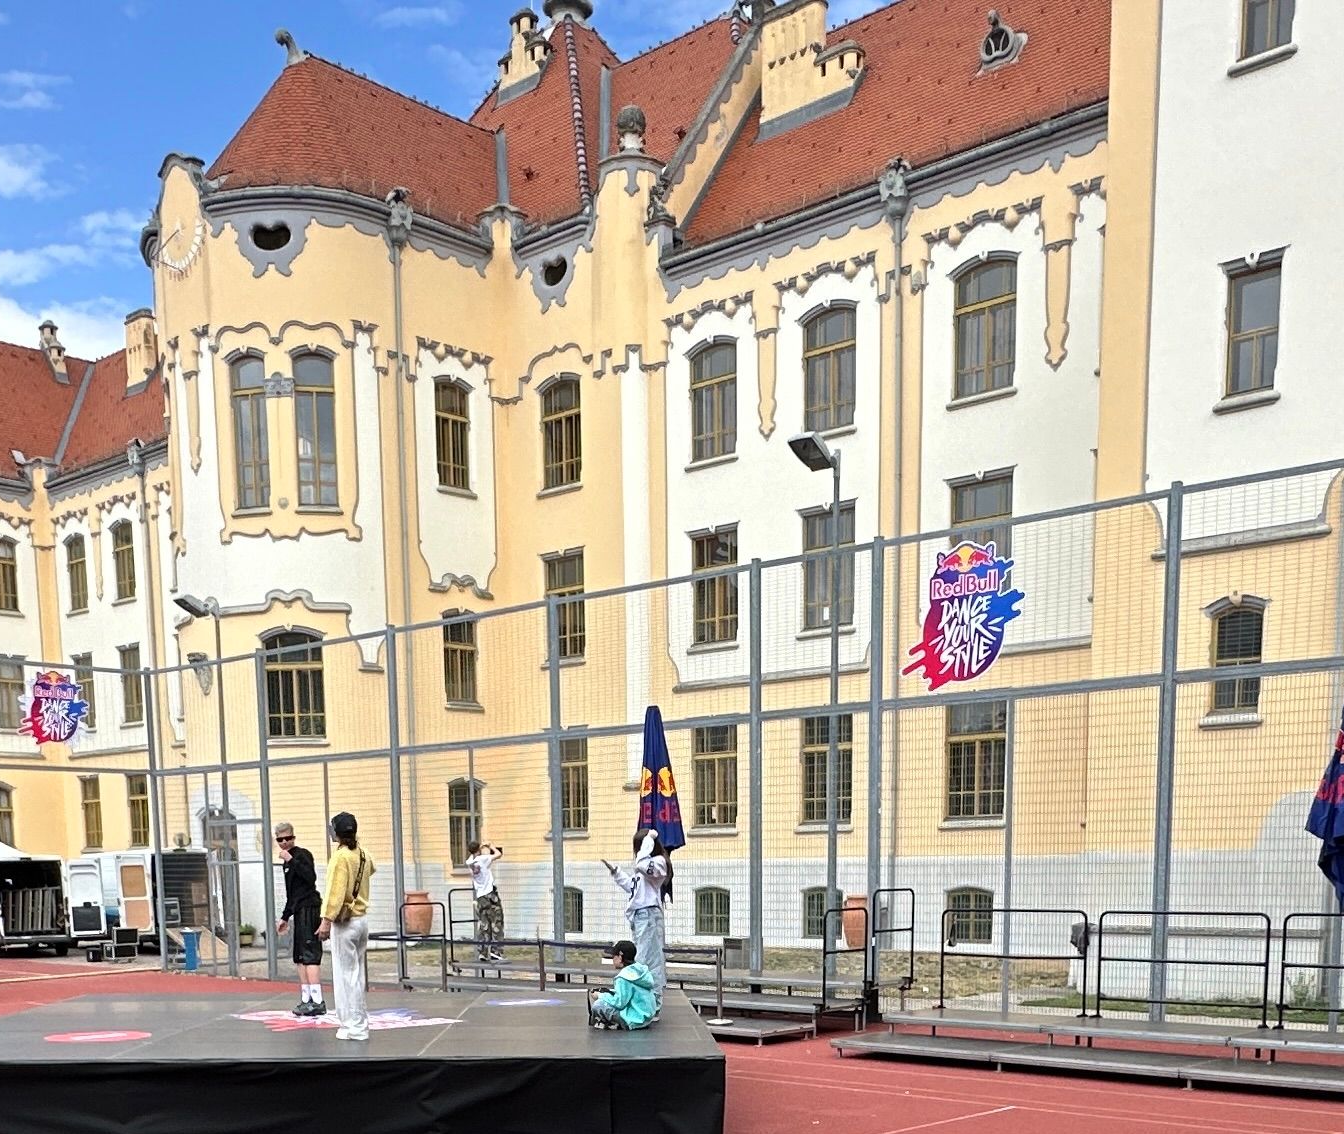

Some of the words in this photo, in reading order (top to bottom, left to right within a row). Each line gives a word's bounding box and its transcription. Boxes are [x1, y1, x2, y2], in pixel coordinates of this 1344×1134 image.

[932, 574, 963, 597] Red
[966, 570, 997, 593] Bull
[937, 595, 992, 631] DANCE
[942, 613, 997, 649] YOUR
[939, 633, 993, 677] STYLE
[35, 685, 54, 697] Red
[39, 698, 71, 713] DANCE
[42, 709, 74, 725] YOUR
[41, 721, 73, 740] STYLE
